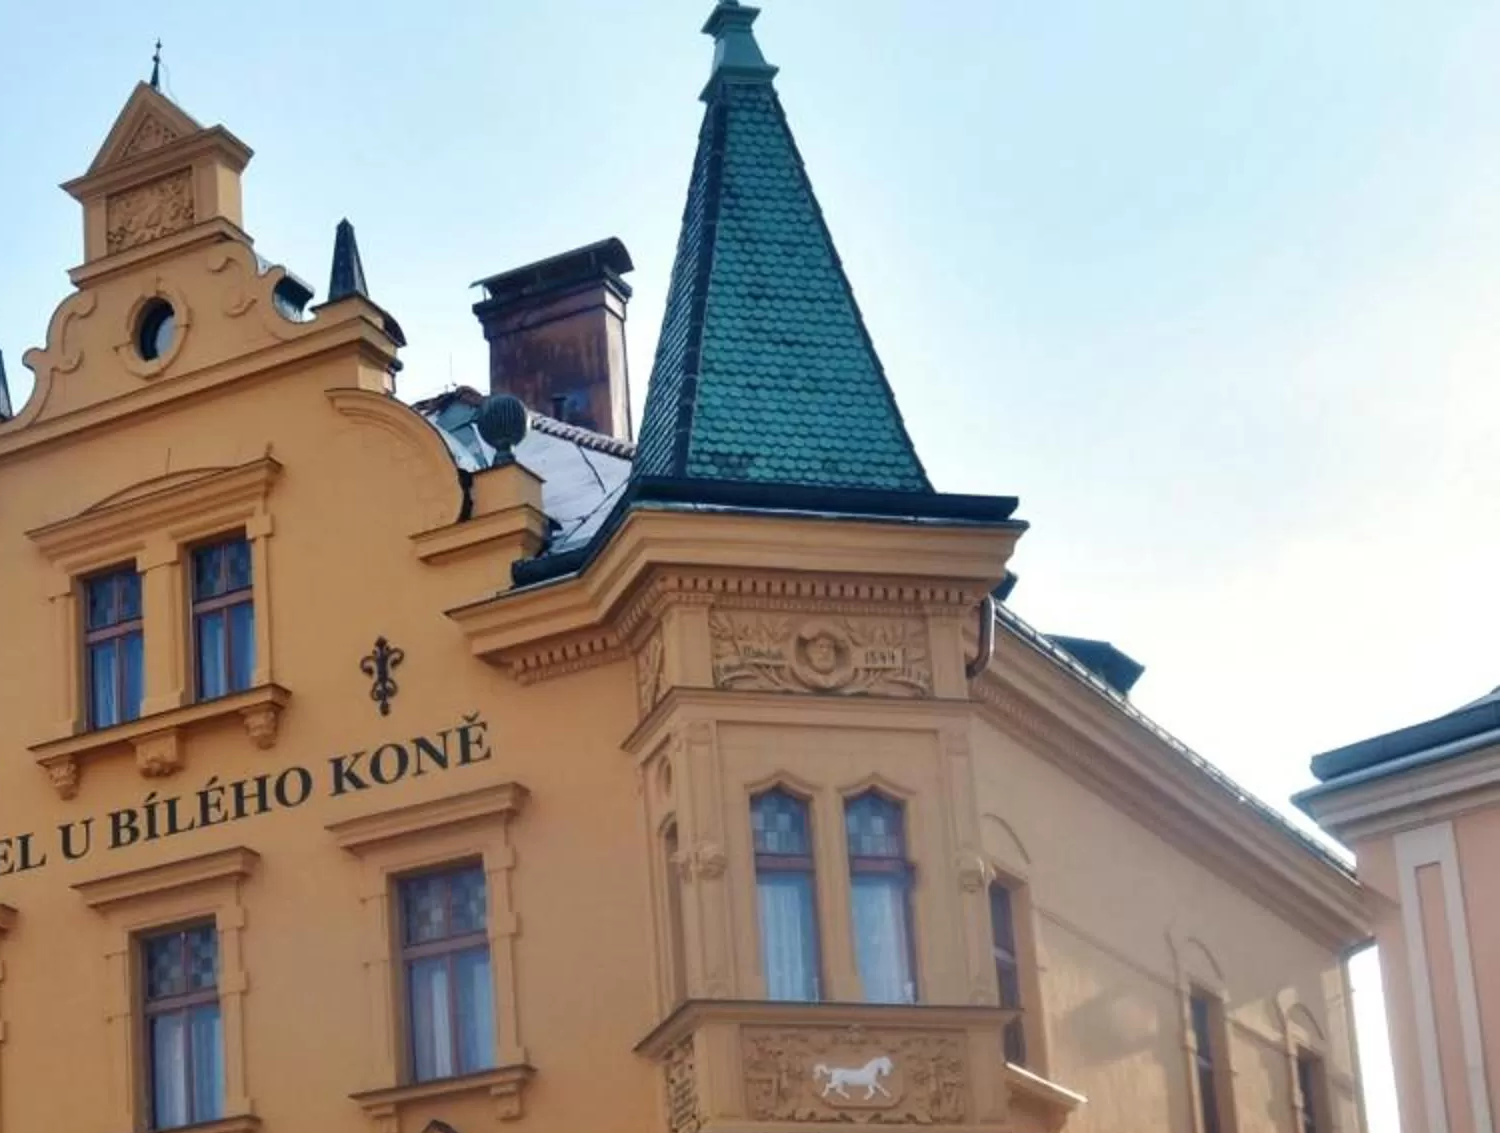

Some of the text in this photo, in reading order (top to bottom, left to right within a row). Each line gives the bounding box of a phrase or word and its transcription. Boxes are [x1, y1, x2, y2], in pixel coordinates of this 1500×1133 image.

[58, 817, 94, 860] U
[106, 765, 313, 849] BÍLÉHO
[328, 712, 493, 797] KONĚ
